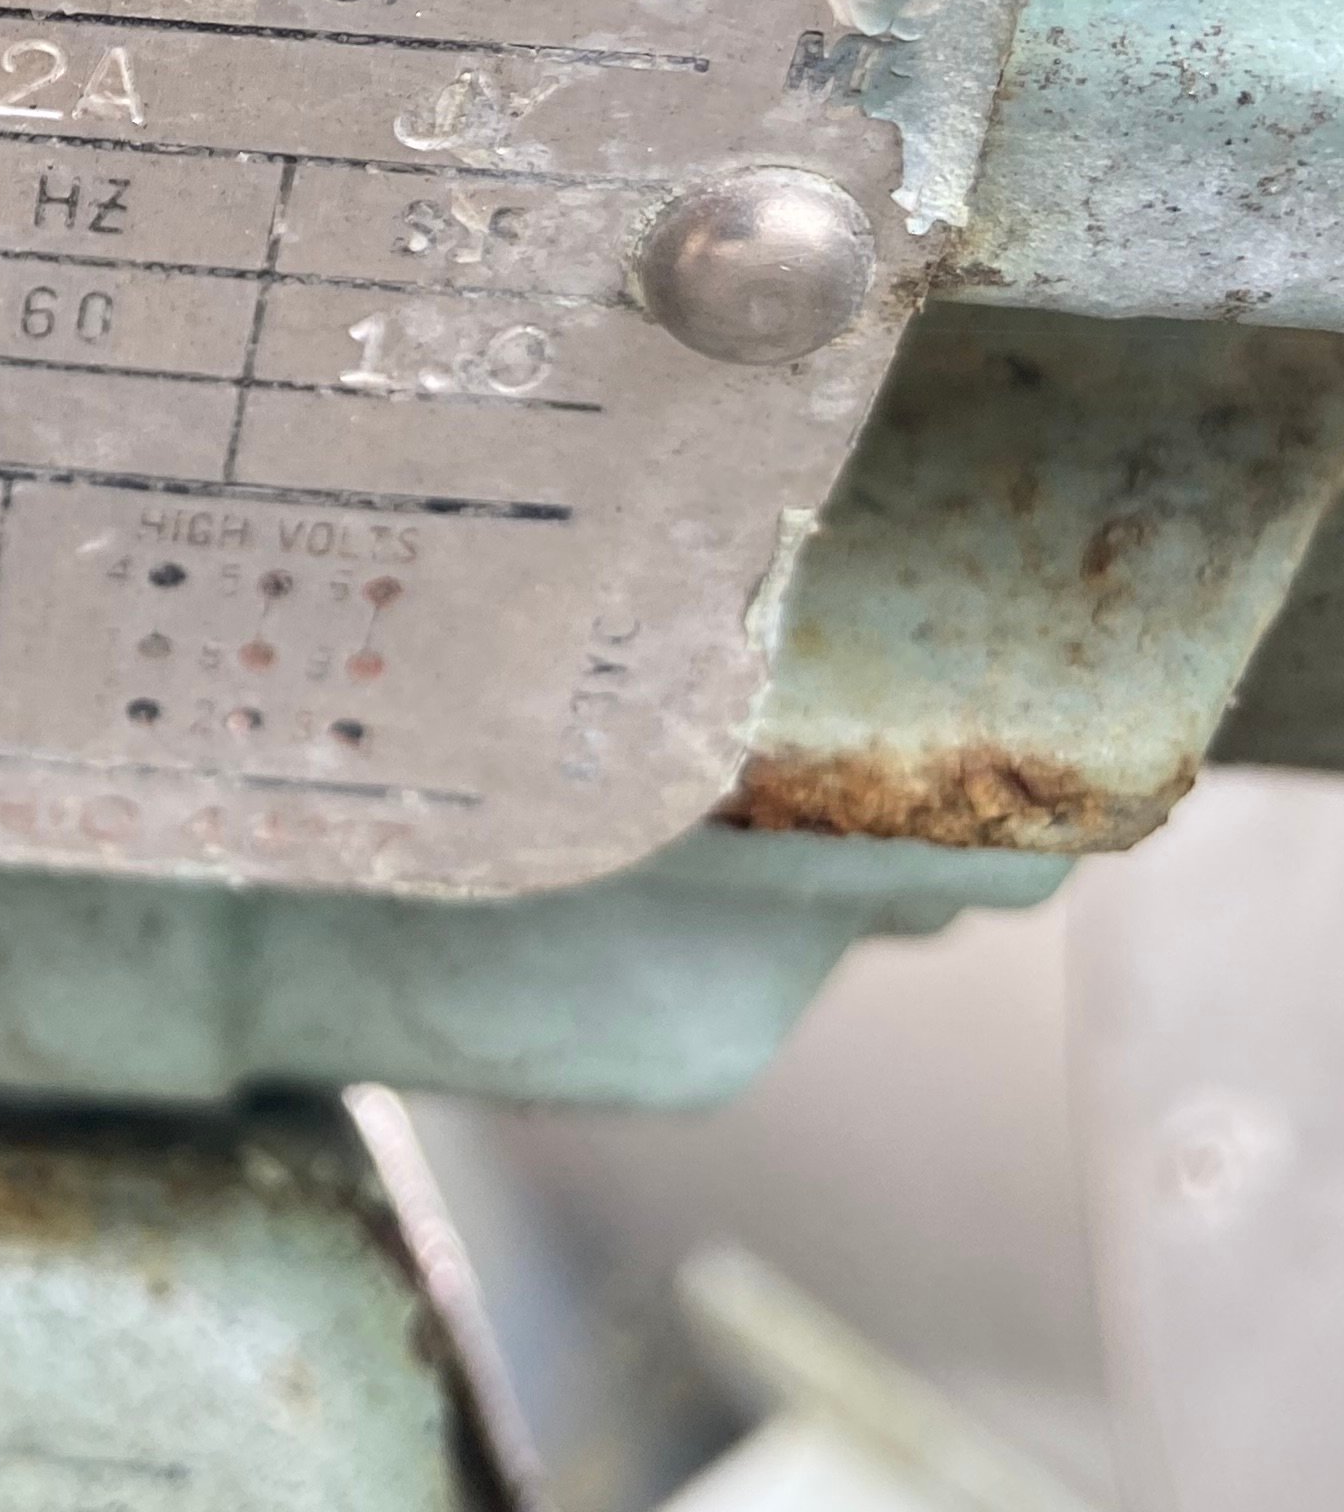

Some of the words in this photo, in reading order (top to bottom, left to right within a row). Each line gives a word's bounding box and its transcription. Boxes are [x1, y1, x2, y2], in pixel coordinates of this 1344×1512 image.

[33, 173, 132, 235] HZ
[20, 284, 114, 345] 60
[138, 507, 250, 549] HIGH
[277, 516, 420, 564] VOLTS
